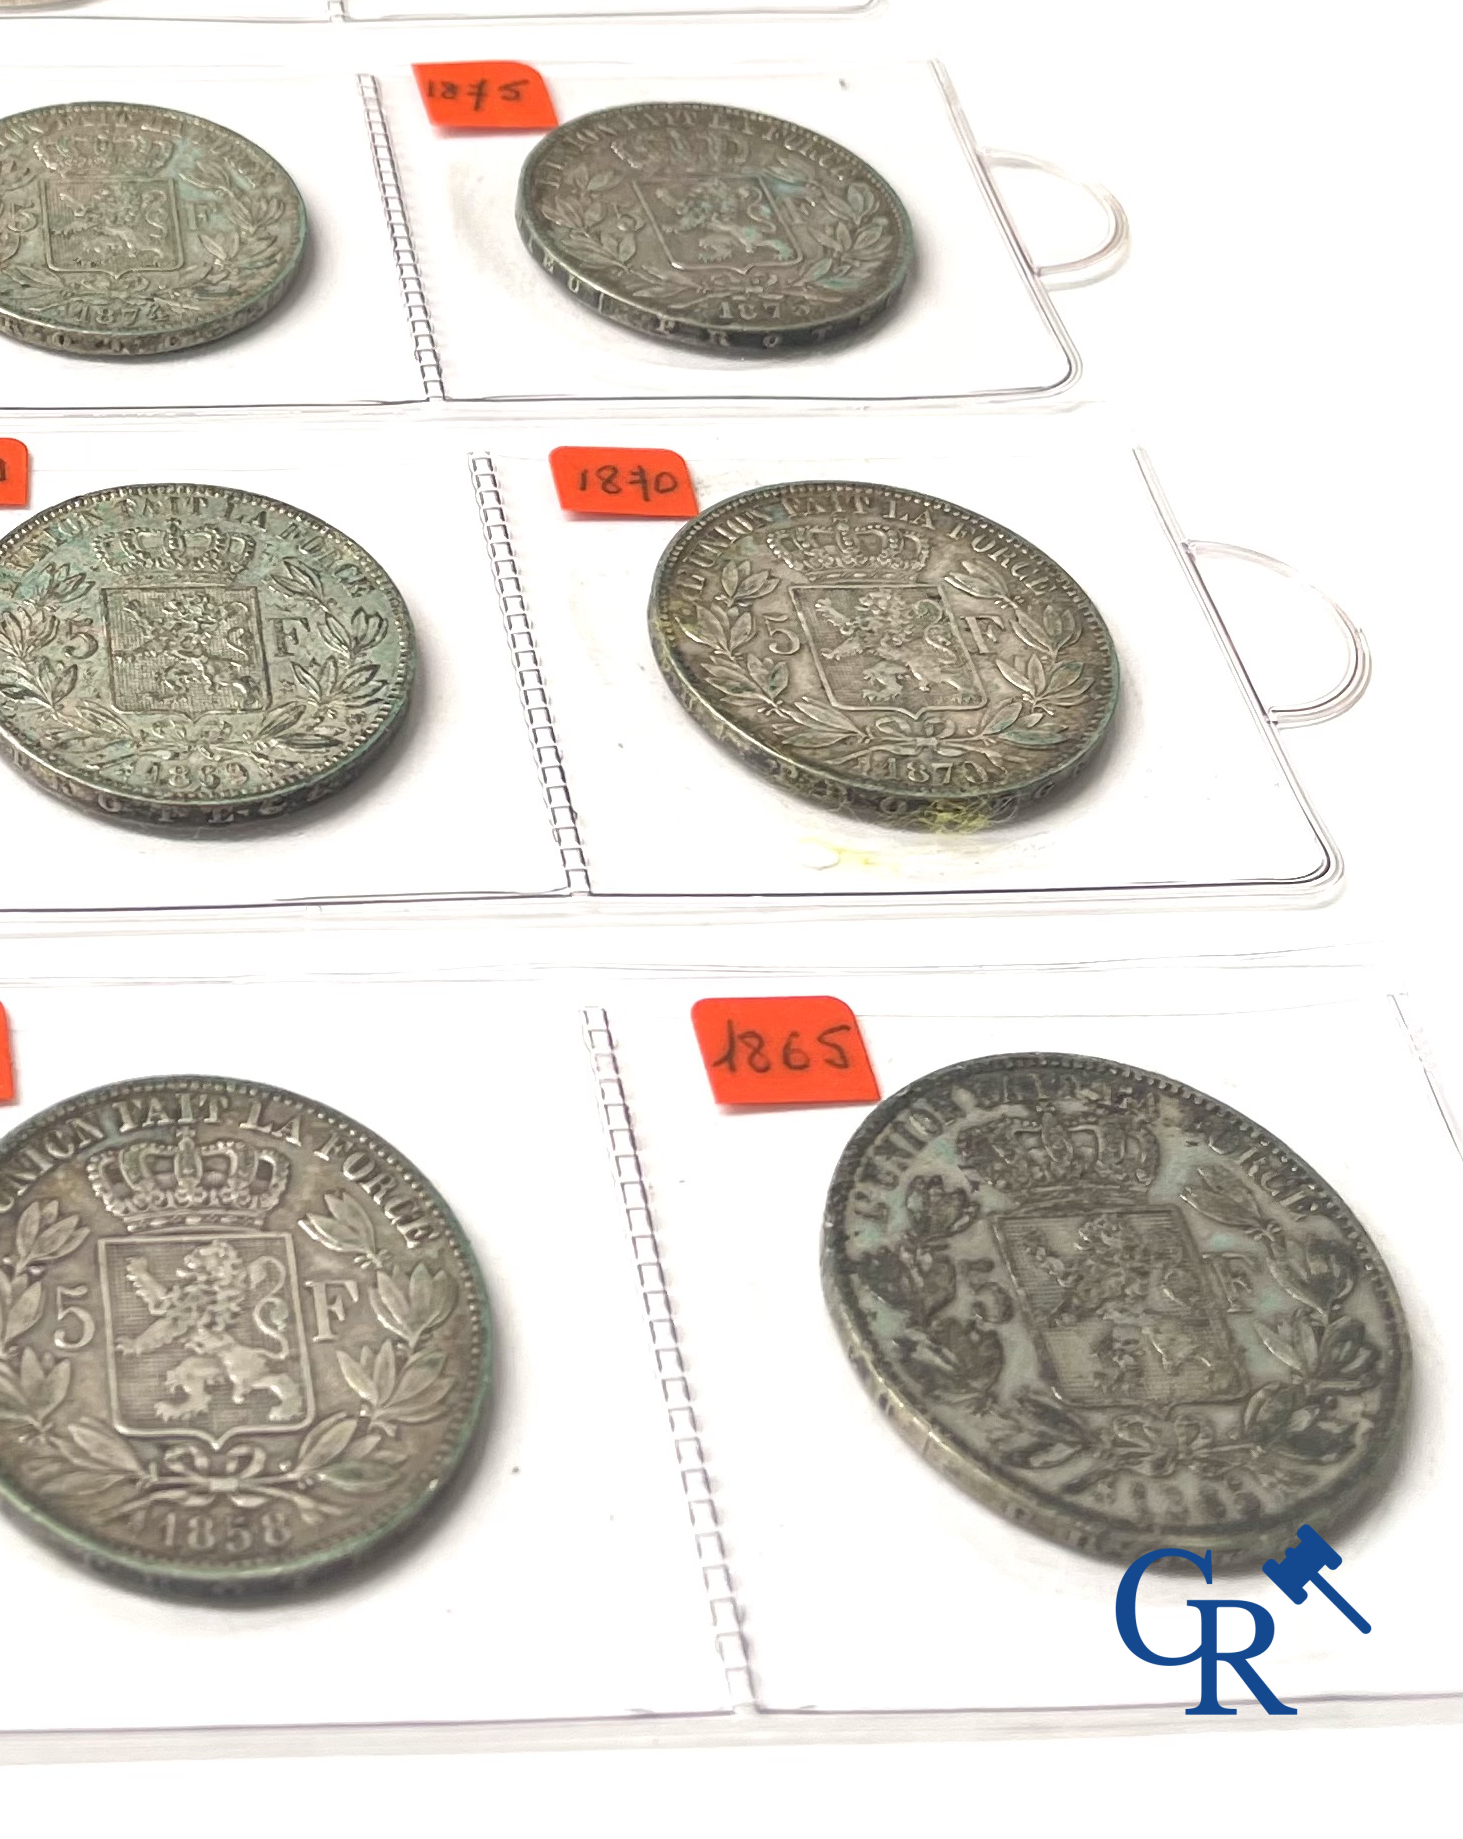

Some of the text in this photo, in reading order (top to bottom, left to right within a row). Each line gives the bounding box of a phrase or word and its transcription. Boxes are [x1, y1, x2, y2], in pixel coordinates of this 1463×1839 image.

[425, 78, 531, 112] 1875
[578, 467, 679, 503] 1870
[62, 614, 312, 661] 5 F
[765, 614, 1009, 657] 5 F
[712, 1018, 856, 1076] 1865
[112, 1092, 230, 1133] FAIT
[238, 1099, 302, 1148] LA
[312, 1129, 441, 1250] FORCE
[53, 1278, 360, 1349] 5 F
[160, 1512, 294, 1553] 1858
